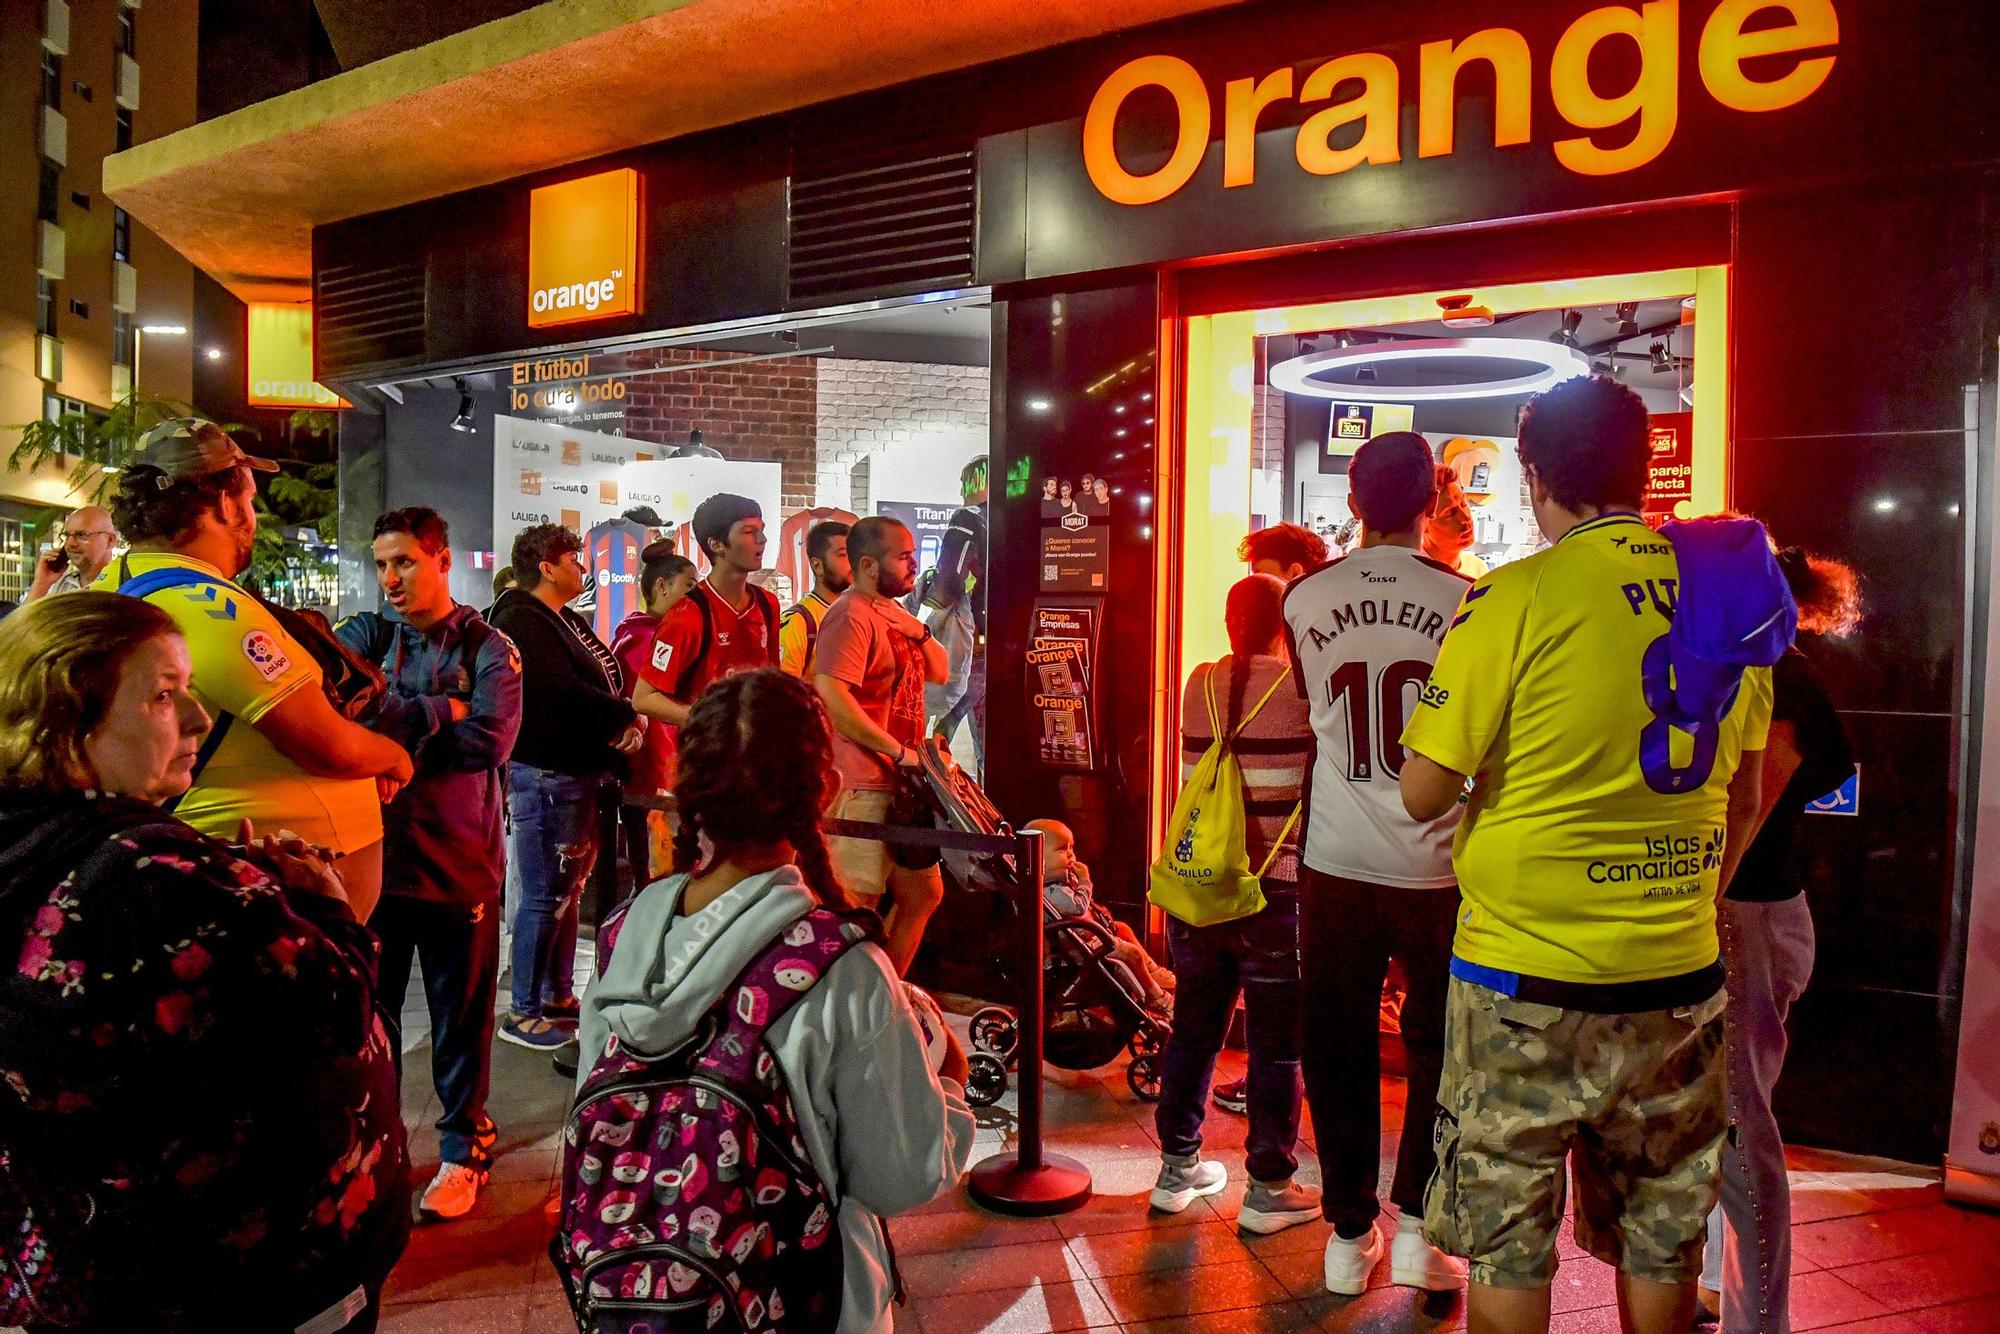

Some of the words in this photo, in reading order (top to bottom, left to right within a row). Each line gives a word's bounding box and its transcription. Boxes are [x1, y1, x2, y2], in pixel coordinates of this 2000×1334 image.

[1083, 0, 1840, 205] Orange
[533, 278, 615, 312] orange
[512, 362, 530, 385] El
[254, 380, 328, 404] orang
[512, 388, 529, 411] lo
[581, 376, 626, 404] todo
[584, 412, 592, 421] lo
[592, 410, 625, 420] tenemos.
[1650, 464, 1692, 479] pareja
[1651, 478, 1685, 490] fecta
[511, 511, 539, 523] LALIGA
[1064, 518, 1085, 527] MORAT
[610, 572, 636, 584] Spotify
[1621, 578, 1679, 616] PIT
[1040, 611, 1071, 622] Orange
[1040, 619, 1081, 630] Empresas
[1026, 650, 1075, 664] Orange
[263, 657, 287, 676] LaLiga
[1034, 694, 1083, 712] Orange
[1326, 660, 1434, 782] 10
[1639, 633, 1720, 795] 8
[1644, 834, 1700, 858] Islas
[1586, 856, 1701, 884] Canarias
[1643, 886, 1674, 899] LATITUD
[1675, 886, 1685, 895] DE
